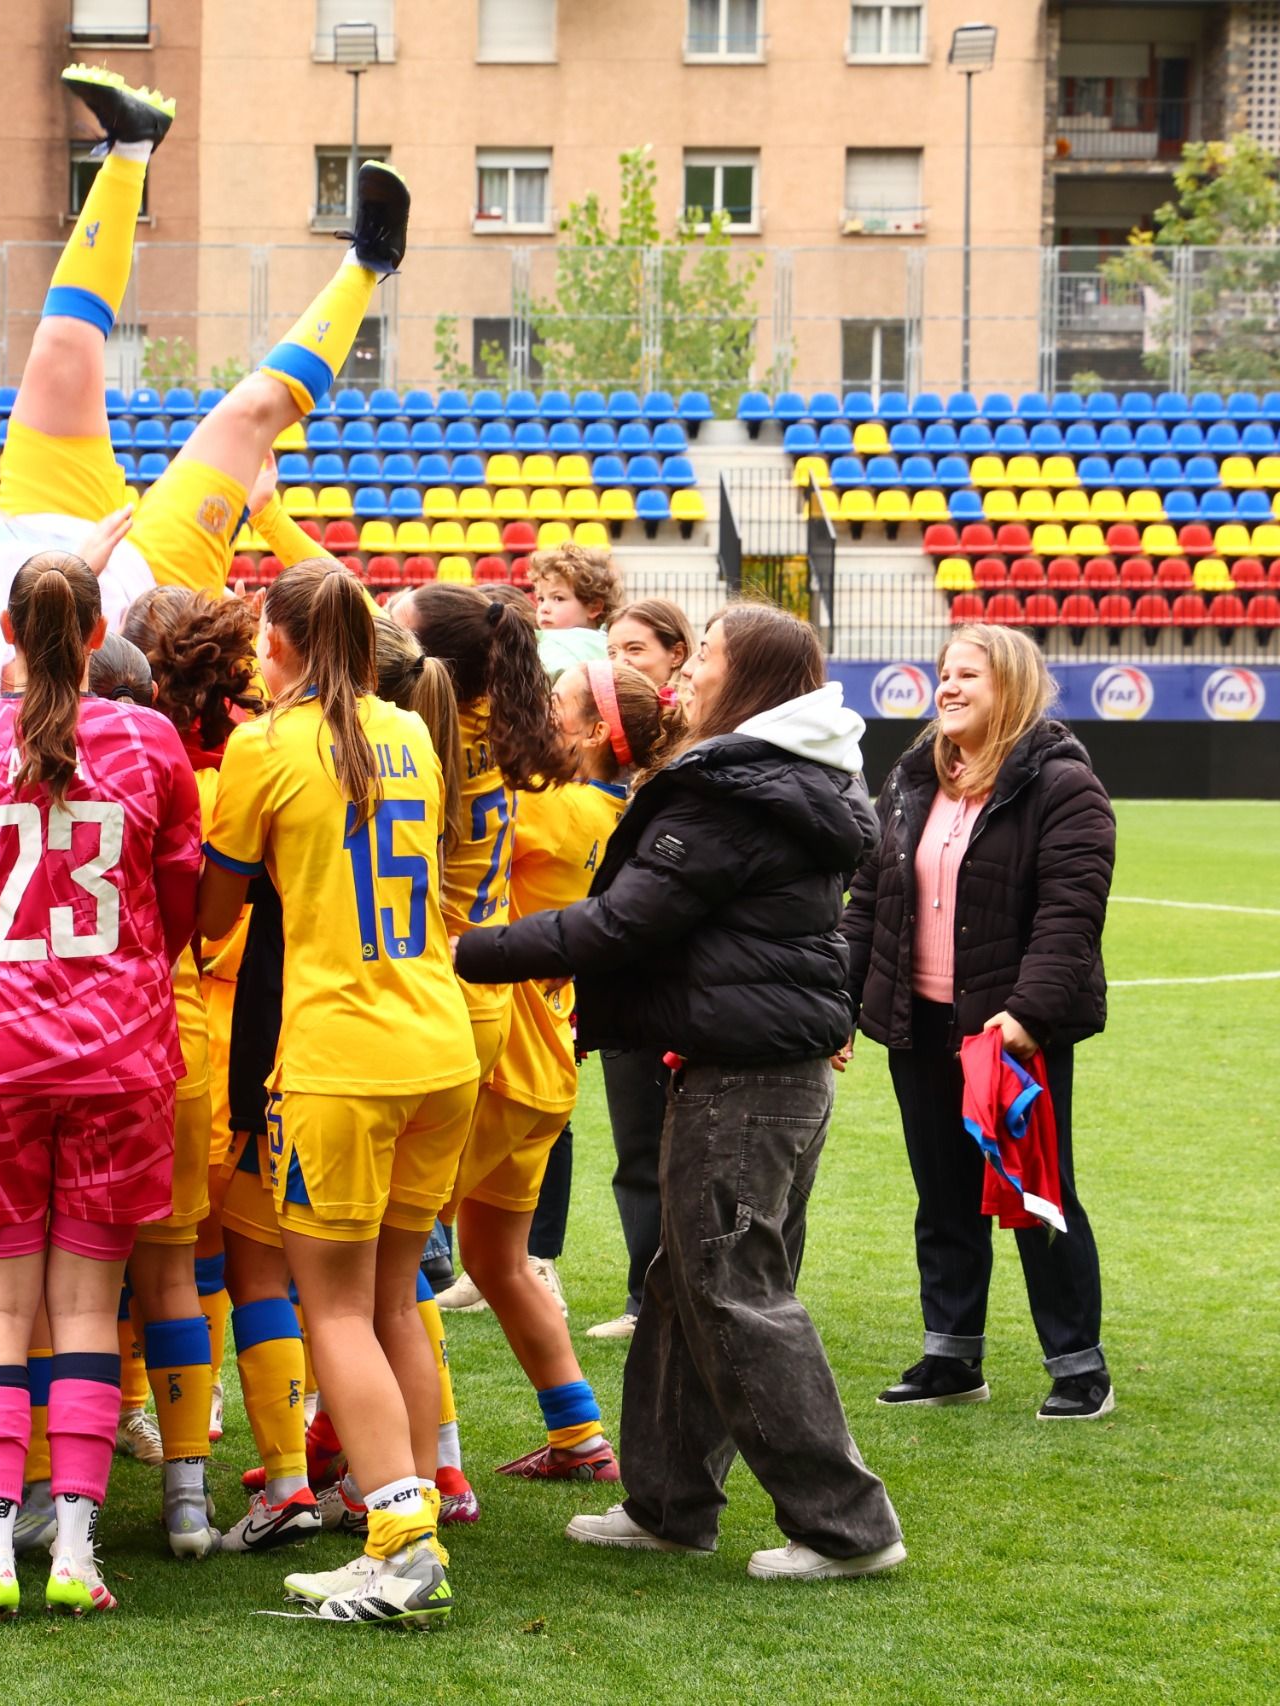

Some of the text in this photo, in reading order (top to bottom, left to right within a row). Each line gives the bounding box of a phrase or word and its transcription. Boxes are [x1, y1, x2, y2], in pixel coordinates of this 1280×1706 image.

[887, 686, 915, 700] FAF
[1107, 688, 1135, 702] FAF
[1219, 689, 1246, 702] FAF
[342, 799, 429, 961] 15
[168, 1373, 183, 1403] FAF
[289, 1379, 301, 1408] FAF
